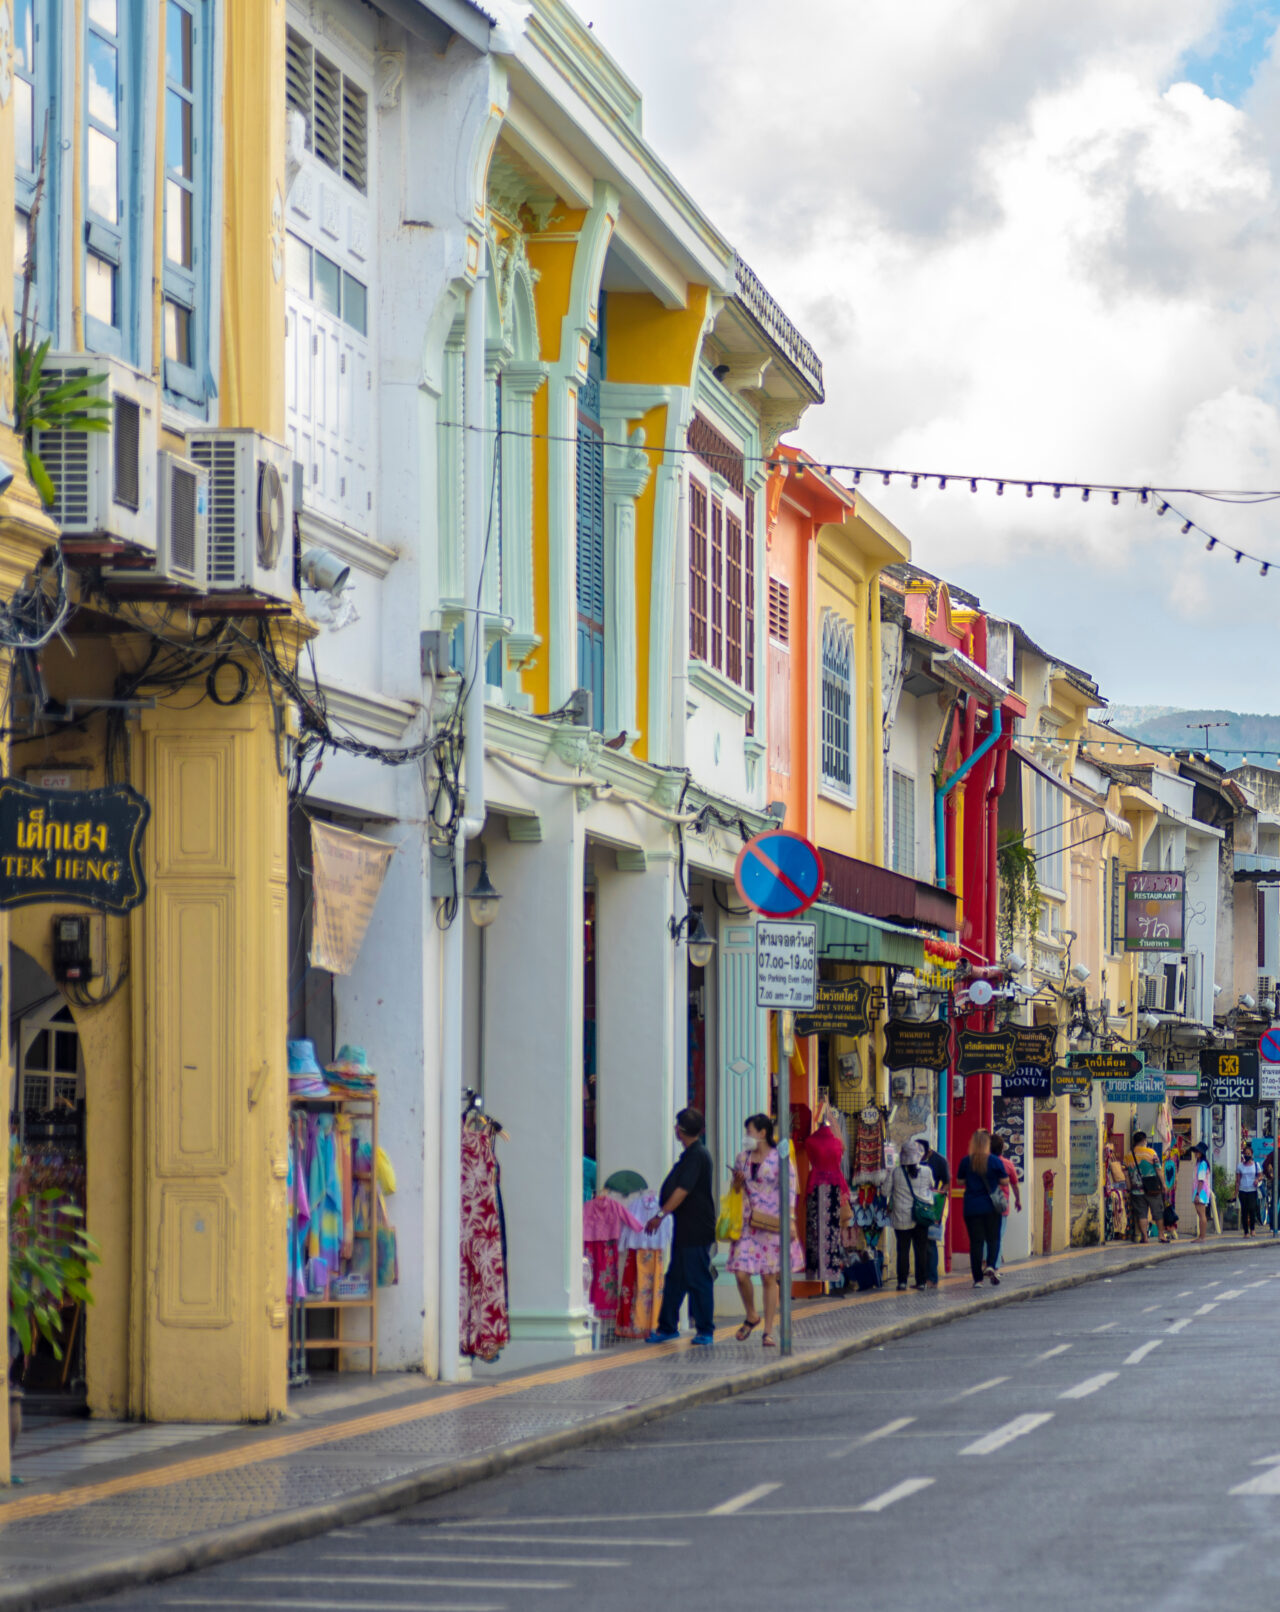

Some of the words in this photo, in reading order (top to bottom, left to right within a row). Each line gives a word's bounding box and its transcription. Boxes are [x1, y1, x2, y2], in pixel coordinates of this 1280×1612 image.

[17, 808, 108, 853] เต็กเฮง
[2, 857, 45, 878] TEK
[55, 858, 119, 881] HENG
[759, 953, 813, 970] 07.00-19.00
[759, 974, 766, 982] No
[768, 974, 787, 985] Parking
[801, 975, 812, 986] Days
[1004, 1078, 1048, 1087] DONUT
[1213, 1077, 1254, 1086] akiniku
